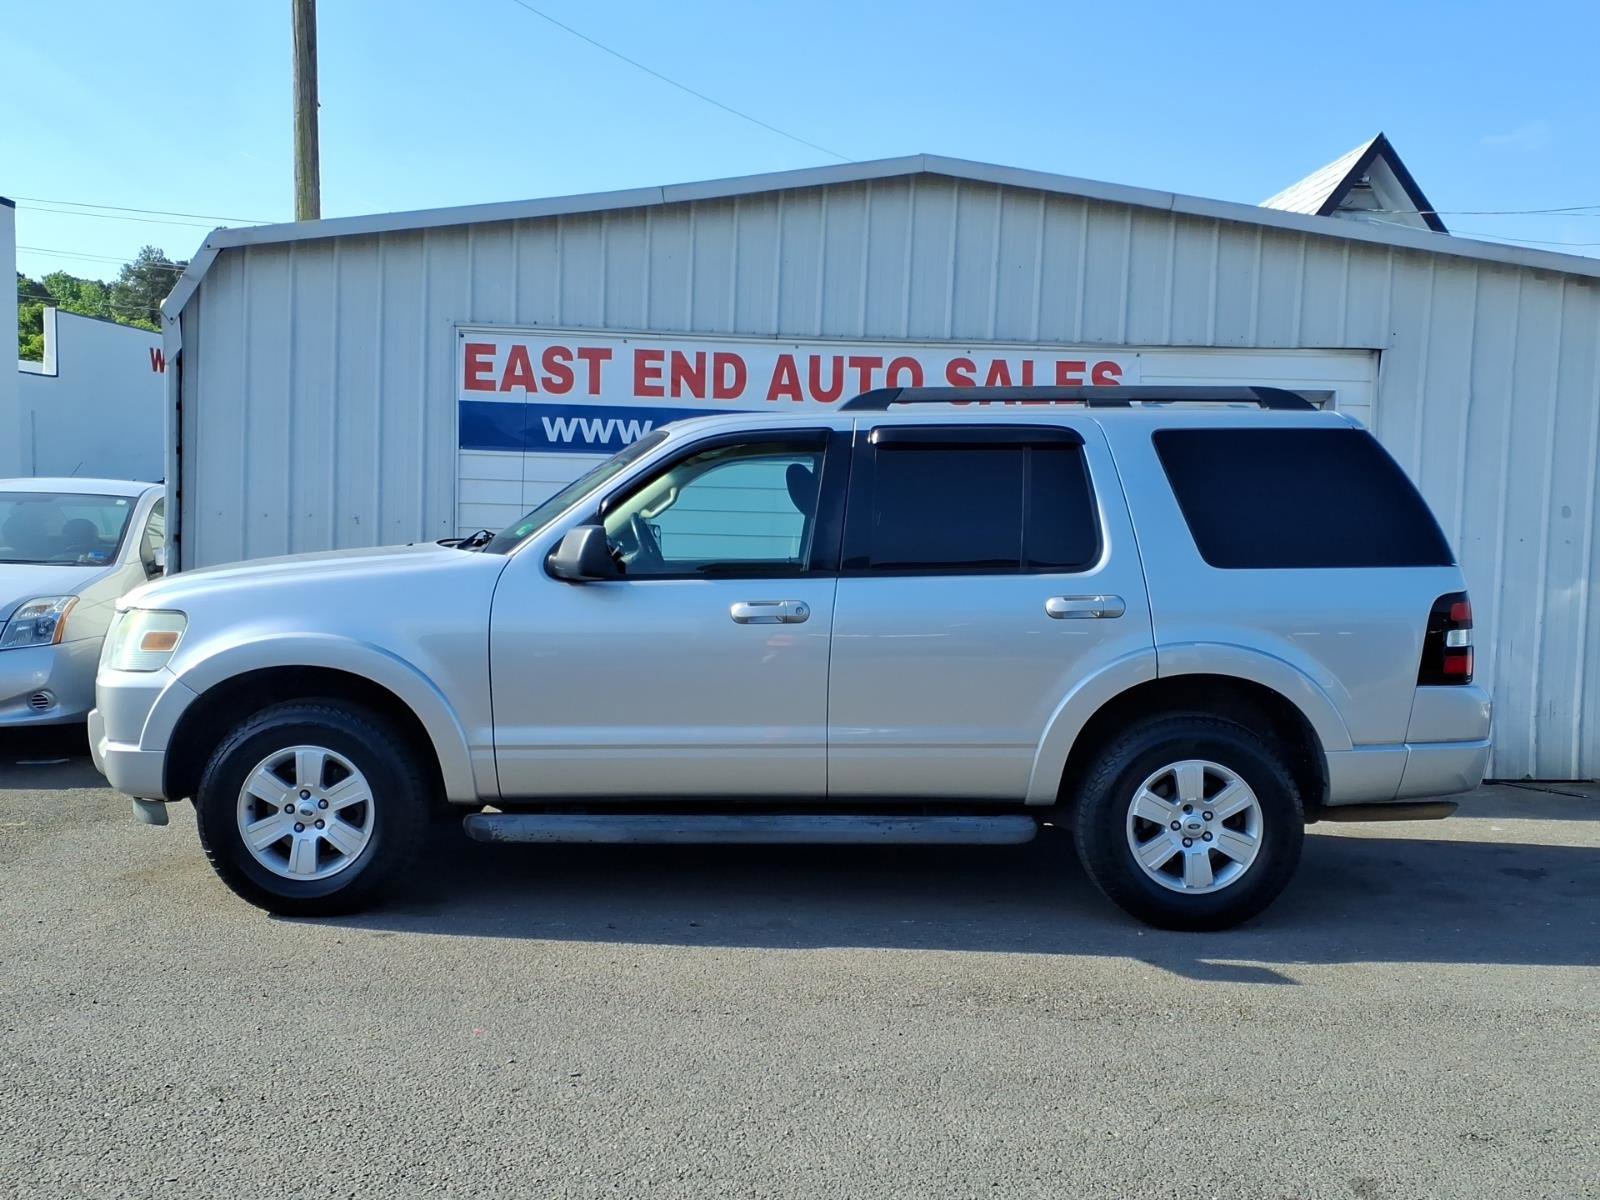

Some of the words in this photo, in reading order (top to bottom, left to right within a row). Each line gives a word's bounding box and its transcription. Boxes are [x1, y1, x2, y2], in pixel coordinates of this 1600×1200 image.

[464, 343, 613, 395] EAST
[633, 348, 747, 400] END
[766, 354, 924, 405] AUTO
